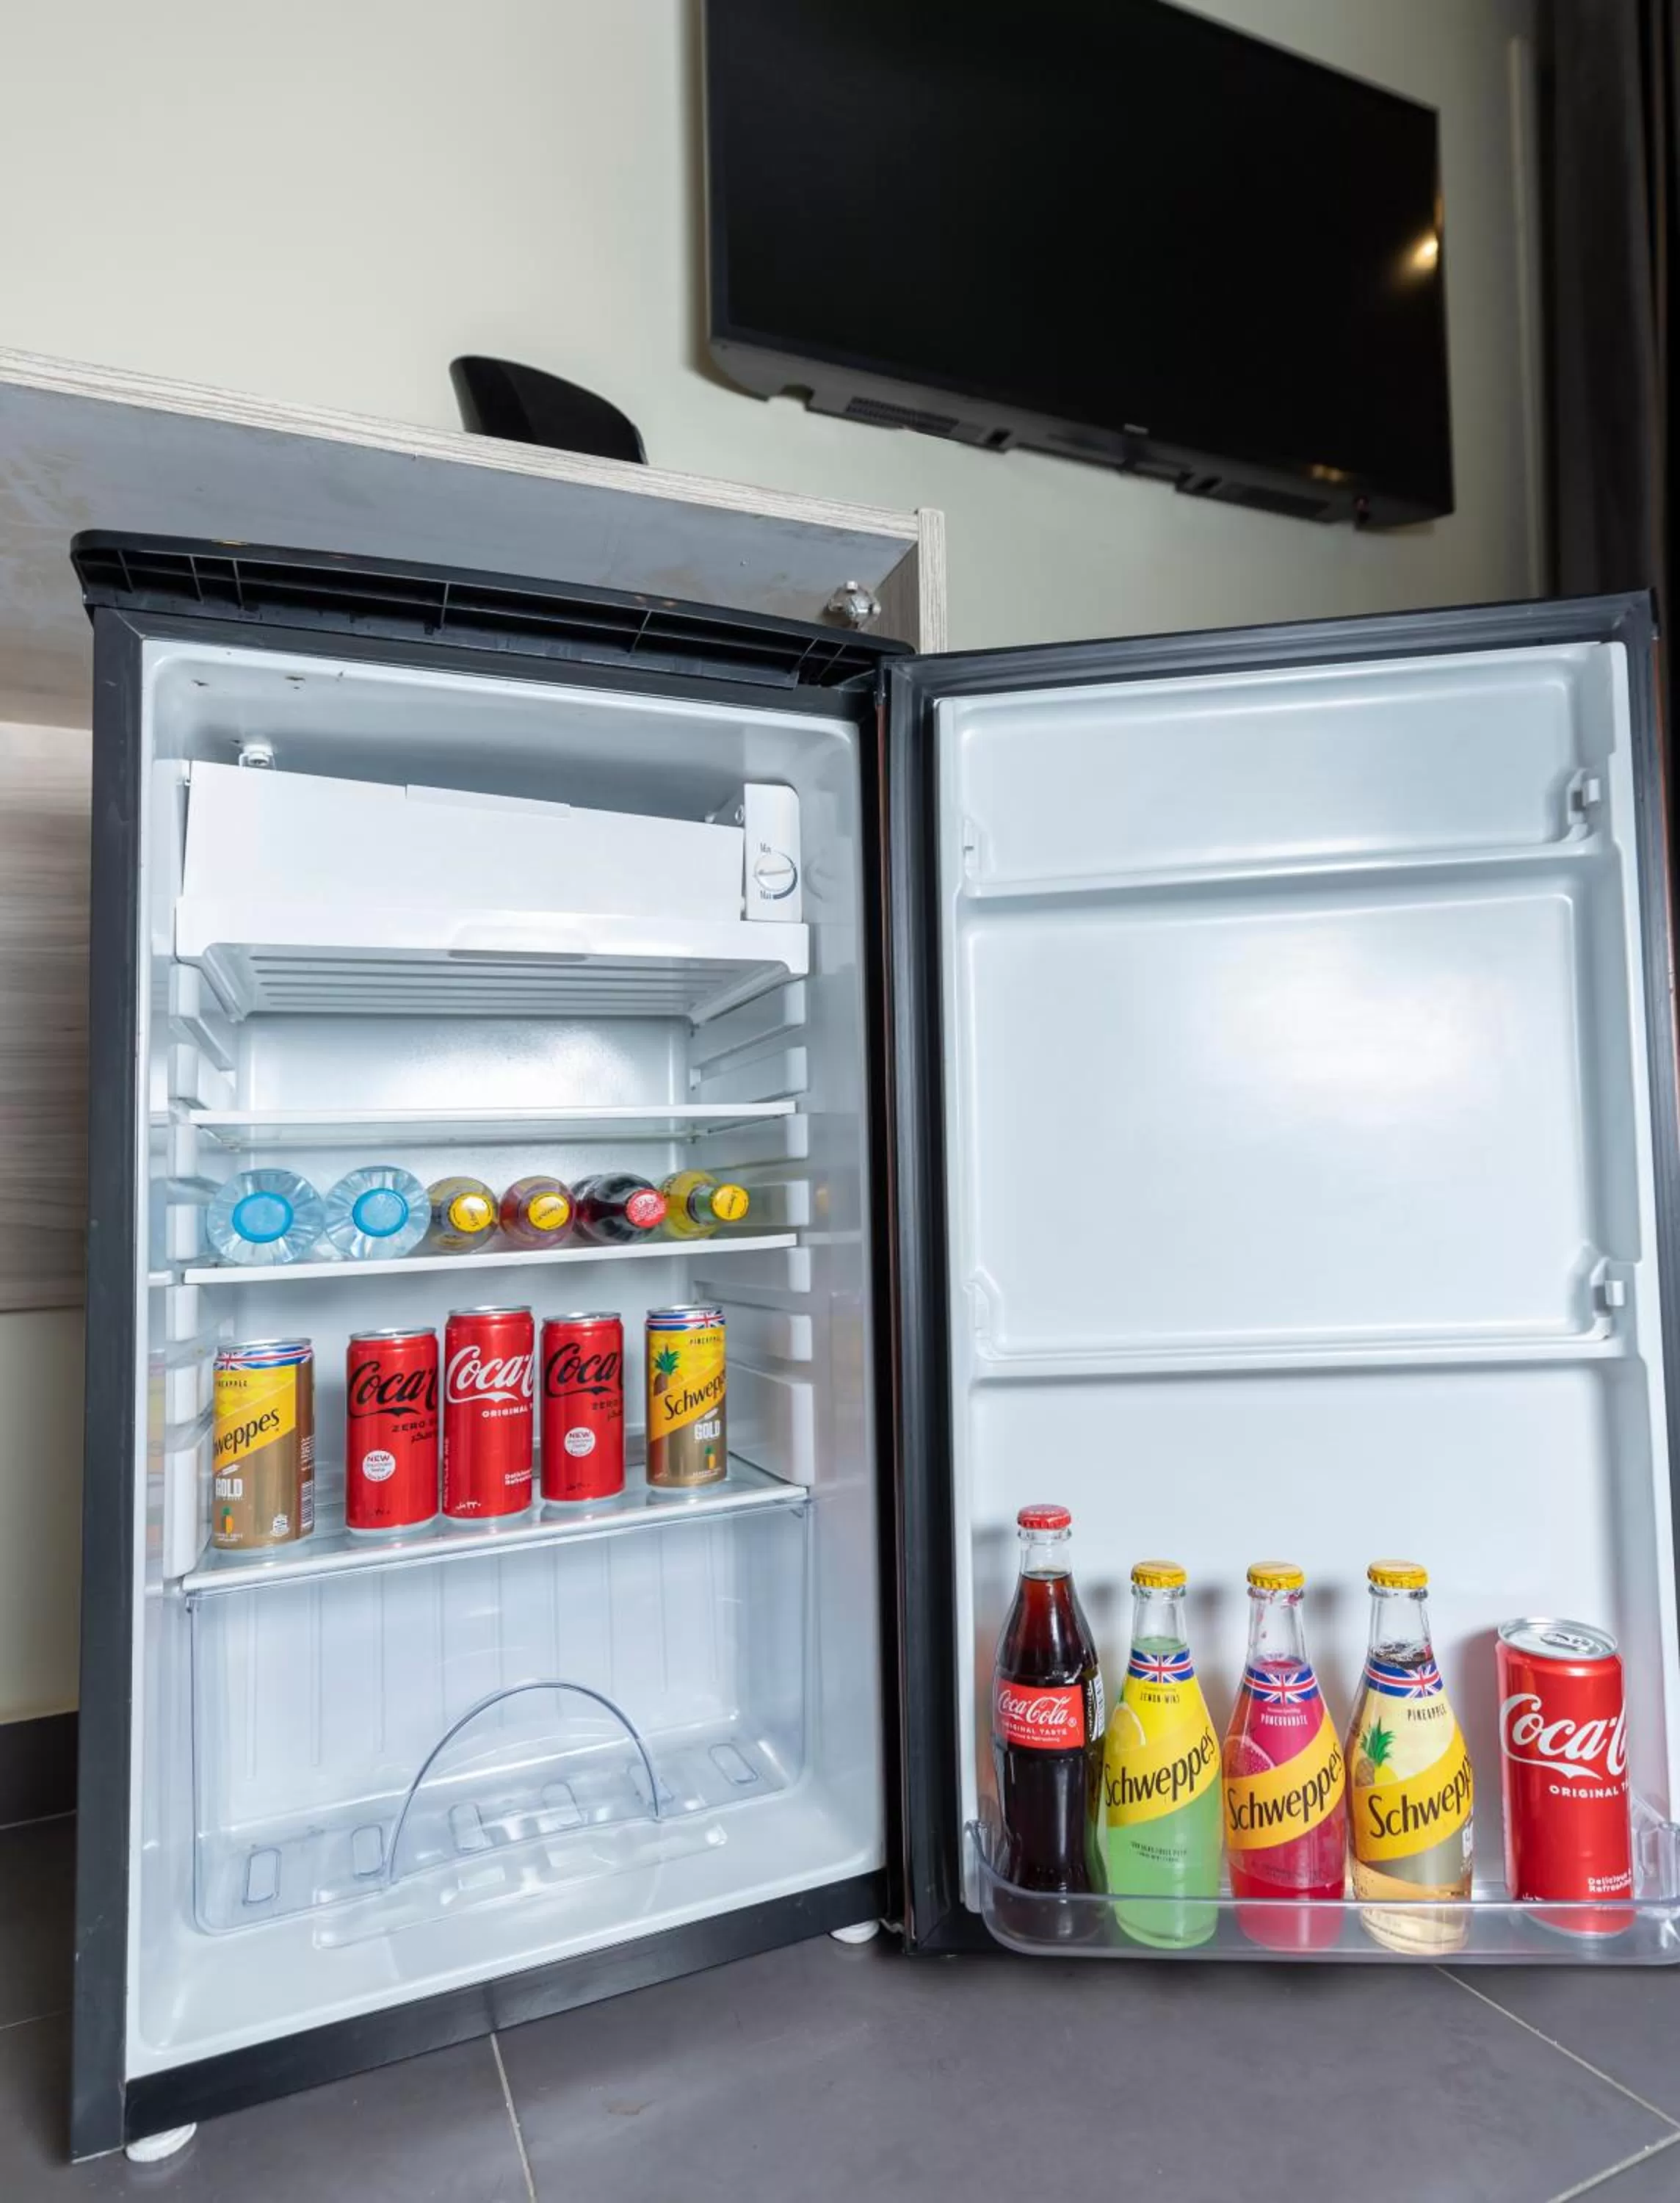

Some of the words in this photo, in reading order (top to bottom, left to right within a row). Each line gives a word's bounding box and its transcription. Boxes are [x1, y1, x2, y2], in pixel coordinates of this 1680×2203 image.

[482, 1406, 529, 1418] ORIGINAL
[694, 1421, 721, 1440] GOLD
[1408, 1703, 1448, 1722] PINEAPPLE
[1104, 1726, 1215, 1807] Schweppes
[1227, 1742, 1343, 1831] Schweppes
[1549, 1784, 1619, 1798] ORIGINAL
